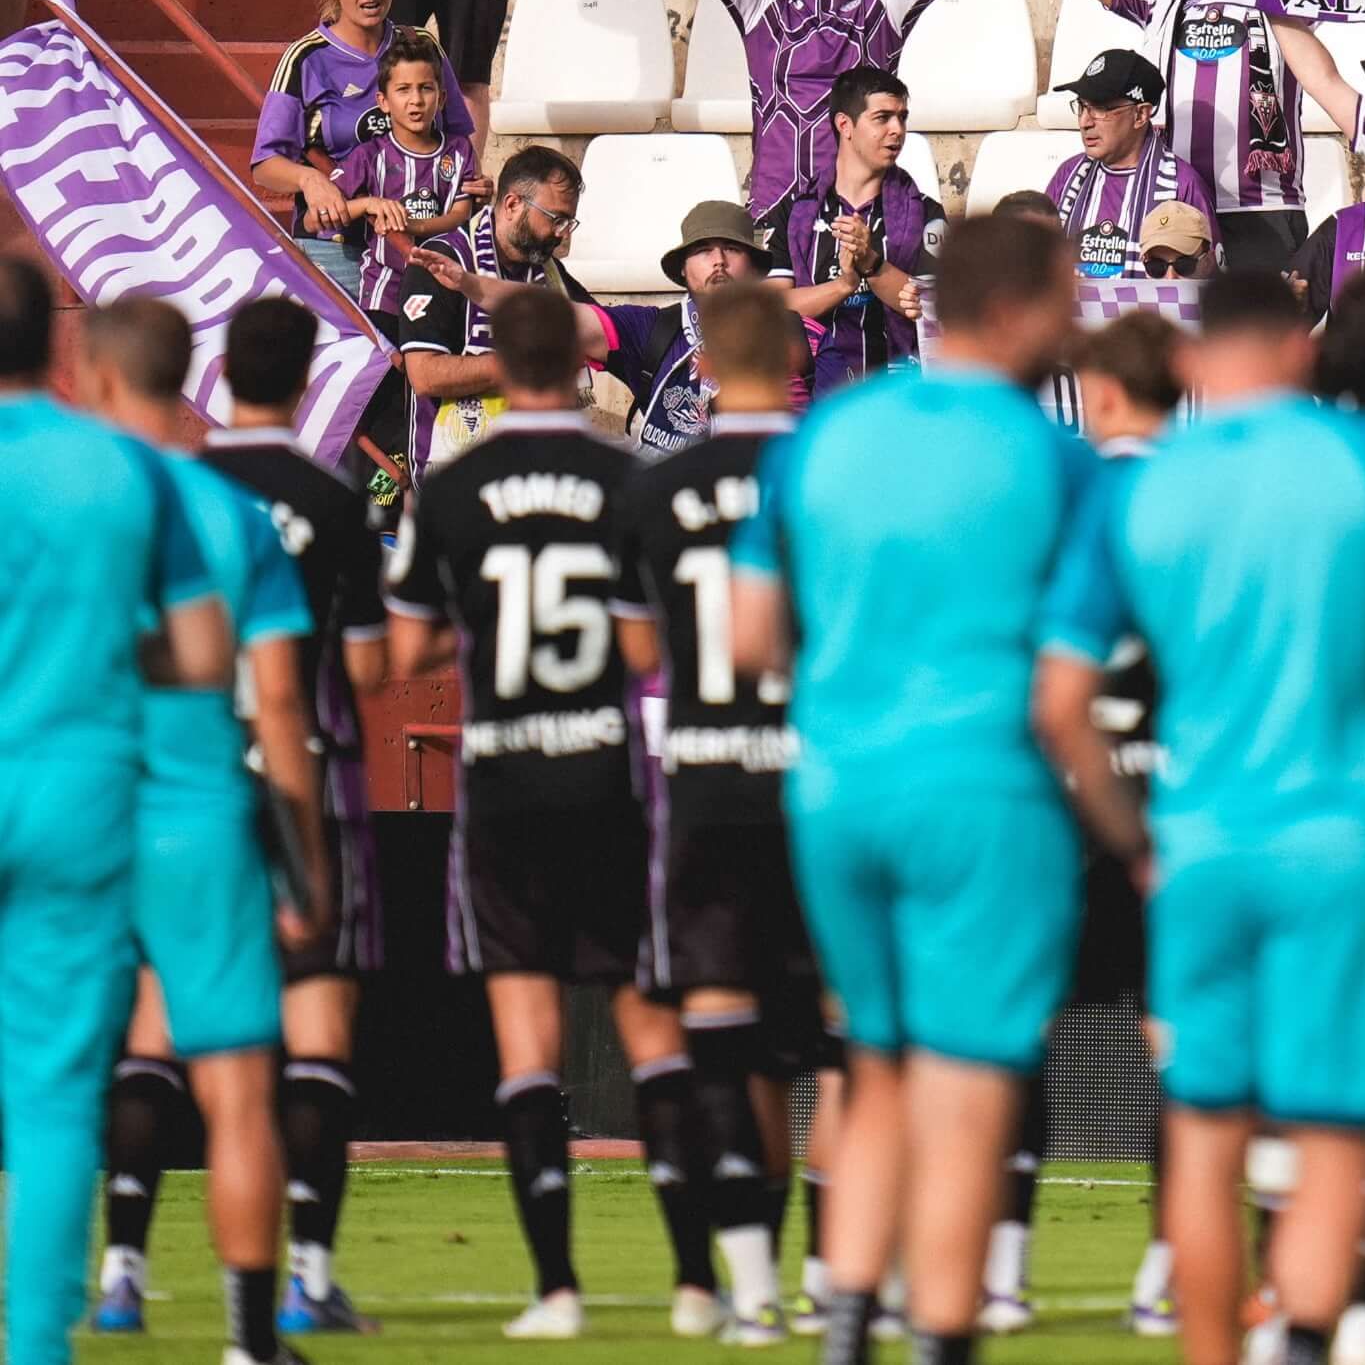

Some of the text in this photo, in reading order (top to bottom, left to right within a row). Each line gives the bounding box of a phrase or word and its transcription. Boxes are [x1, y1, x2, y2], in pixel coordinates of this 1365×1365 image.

[1186, 22, 1235, 36] Estrella
[1185, 34, 1232, 48] Galicia
[1080, 234, 1126, 250] Estrella
[1080, 247, 1122, 263] Galicia
[481, 543, 615, 700] 15
